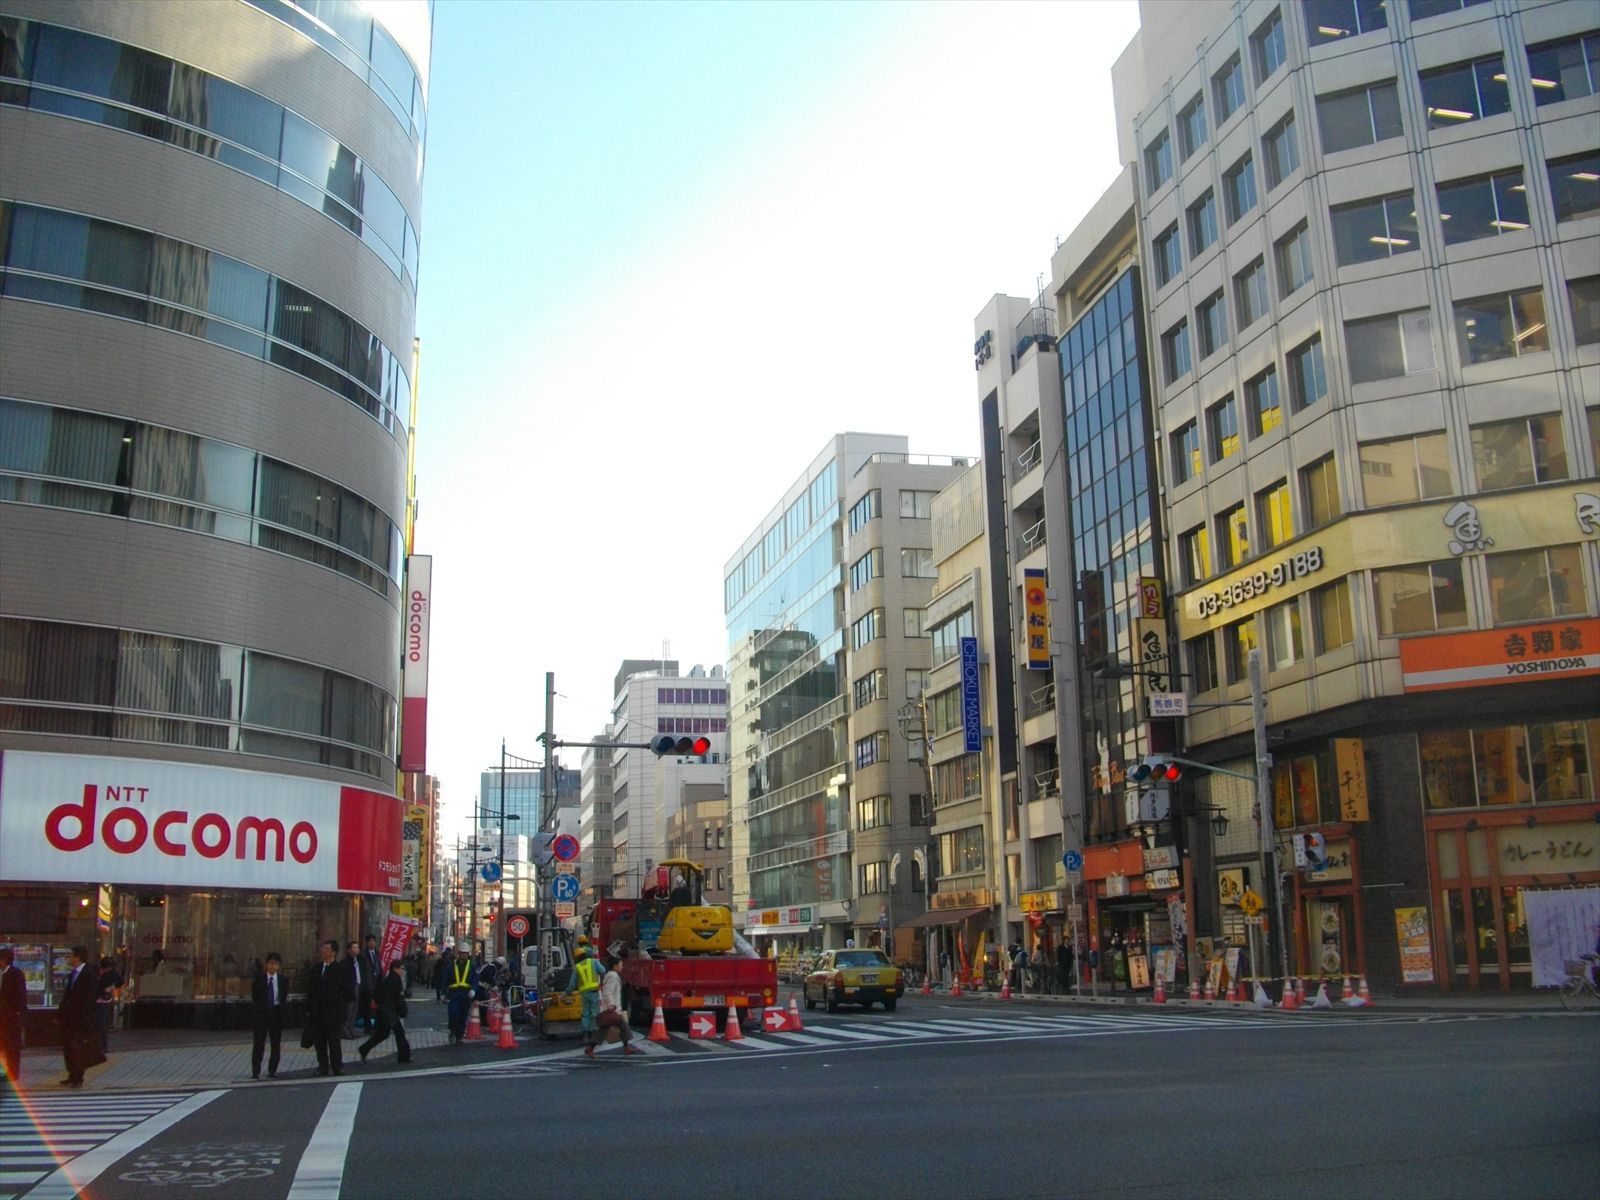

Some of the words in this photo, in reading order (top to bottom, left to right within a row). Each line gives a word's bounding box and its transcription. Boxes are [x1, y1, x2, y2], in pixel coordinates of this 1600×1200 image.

[1198, 545, 1322, 619] 03-3639-9188
[410, 590, 426, 662] docomo
[1029, 612, 1045, 650] 松屋
[1504, 627, 1583, 657] 吉野家
[963, 640, 978, 693] ICHIOKU
[1142, 629, 1167, 693] 魚民
[1506, 657, 1586, 675] YOSHINOYA
[966, 698, 980, 749] MARKET
[106, 785, 149, 804] NTT
[45, 784, 318, 864] docomo
[557, 880, 569, 897] P
[511, 921, 525, 932] 50
